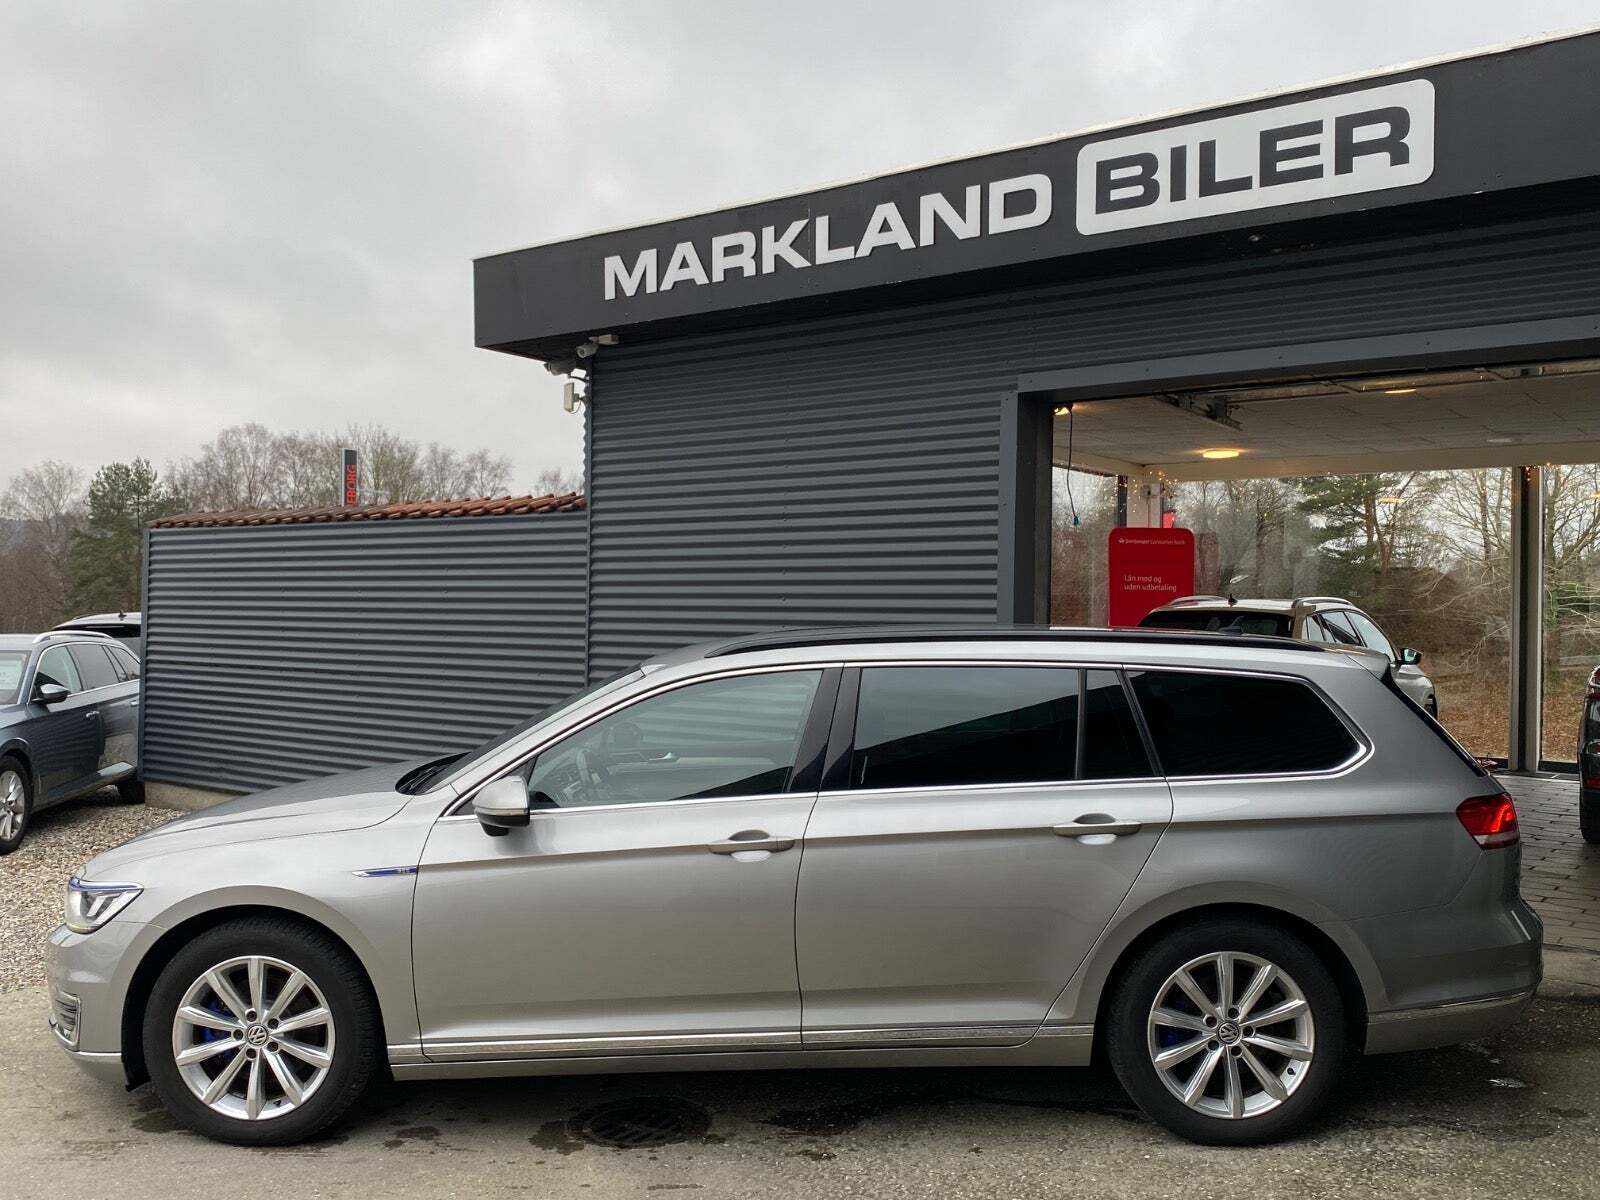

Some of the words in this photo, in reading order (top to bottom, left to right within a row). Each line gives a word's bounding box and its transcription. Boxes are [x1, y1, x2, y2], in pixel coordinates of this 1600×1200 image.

[604, 173, 1053, 301] MARKLAND
[1095, 106, 1411, 215] BILER
[1153, 576, 1162, 584] og
